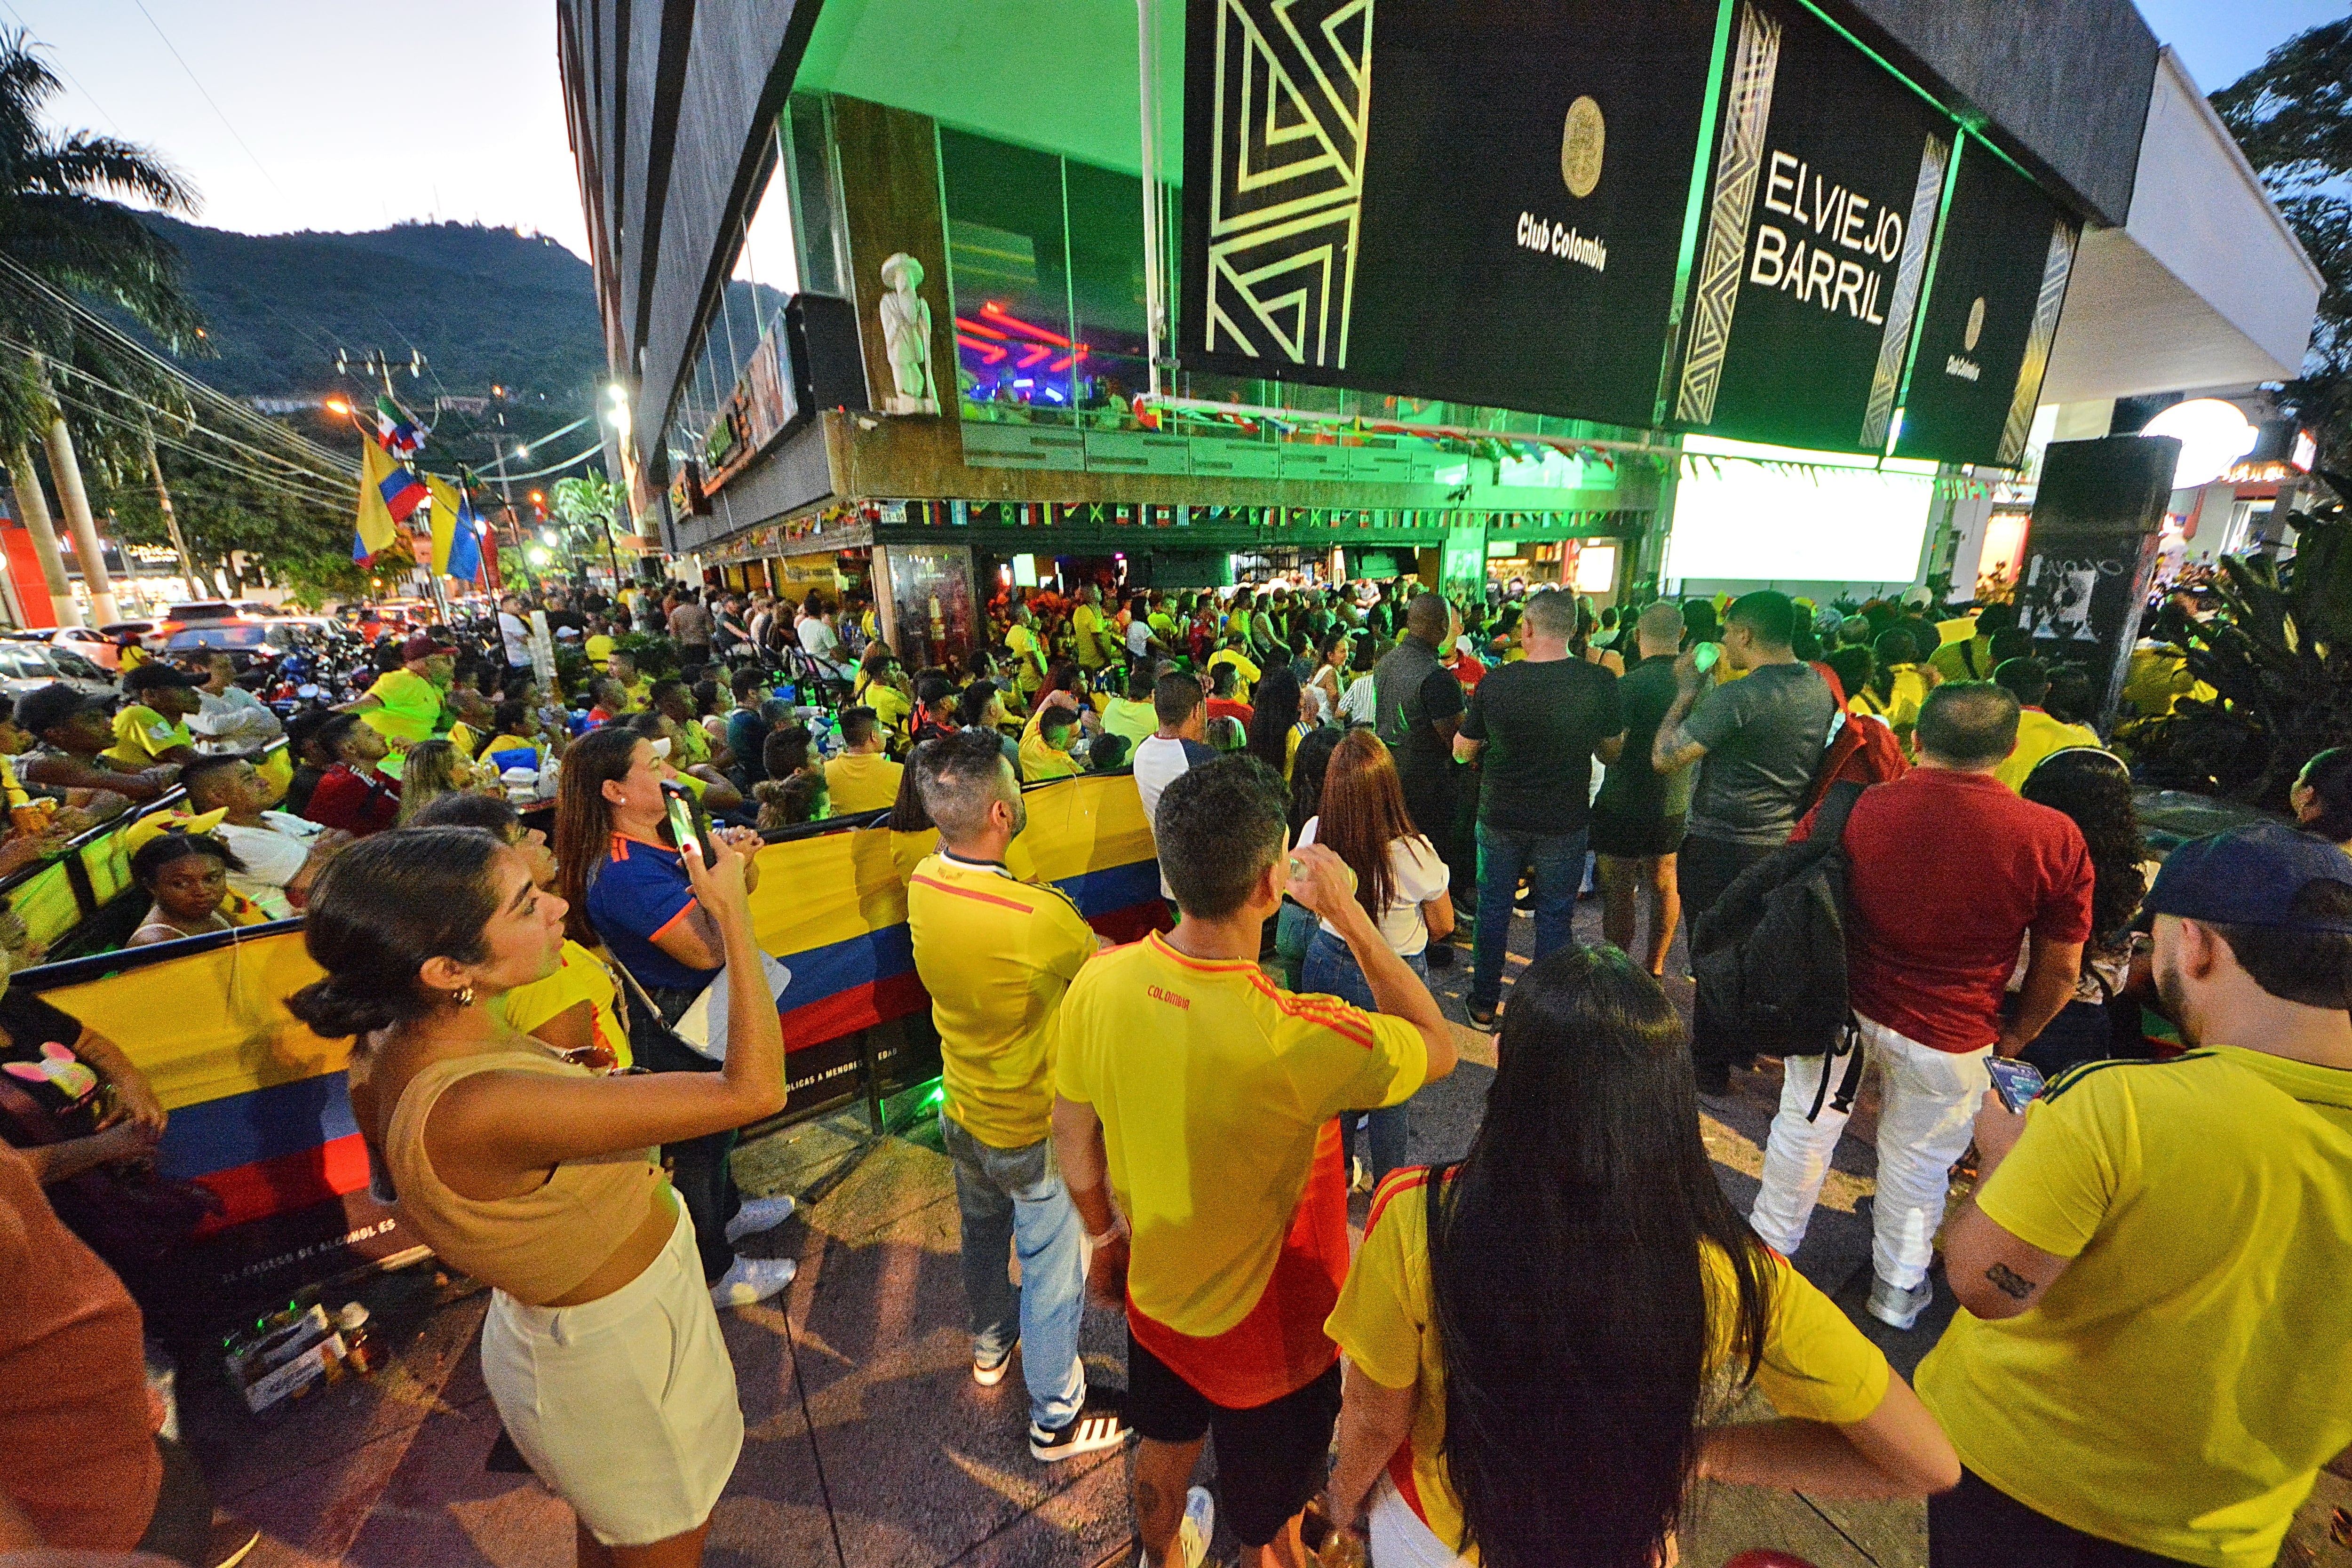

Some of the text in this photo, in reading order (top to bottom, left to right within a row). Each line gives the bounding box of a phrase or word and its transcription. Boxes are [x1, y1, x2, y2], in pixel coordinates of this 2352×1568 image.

[1518, 211, 1607, 272] Club Colombia
[1750, 224, 1883, 325] BARRIL
[1148, 985, 1190, 1010] COLOMBIA
[785, 1075, 815, 1093] OLICAS
[818, 1073, 823, 1082] A
[878, 1048, 897, 1060] EDAD
[378, 1218, 396, 1233] ES
